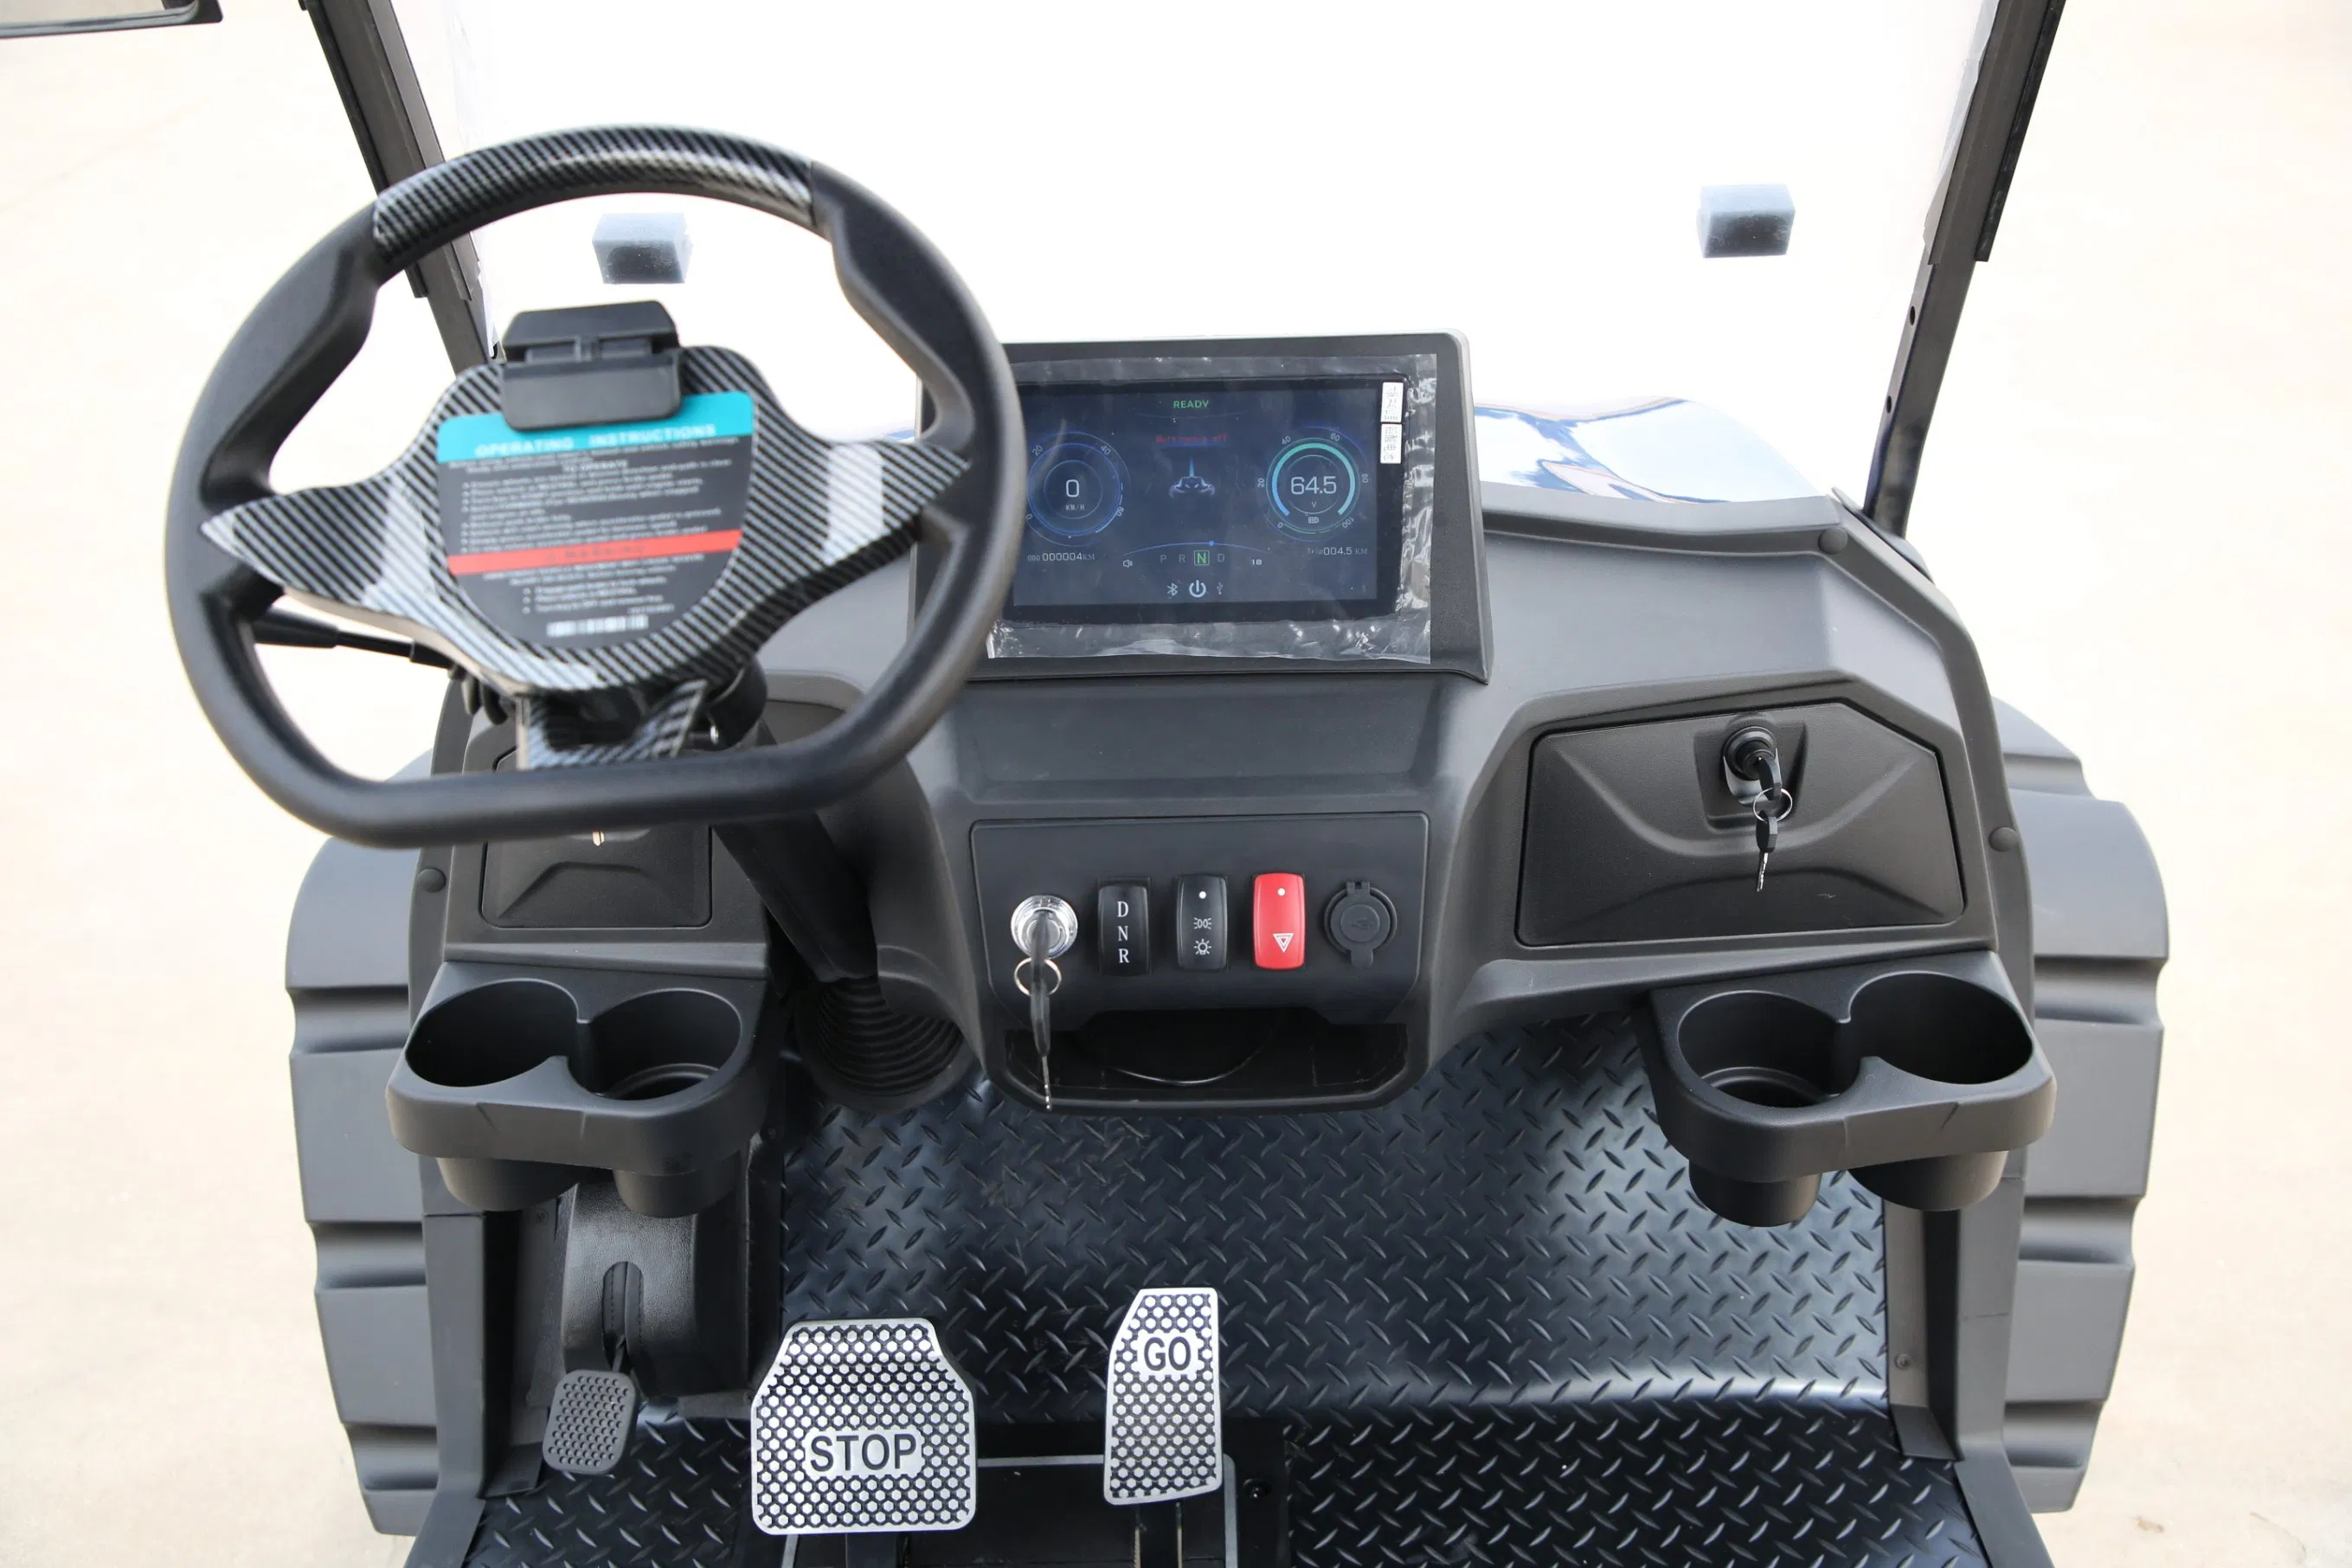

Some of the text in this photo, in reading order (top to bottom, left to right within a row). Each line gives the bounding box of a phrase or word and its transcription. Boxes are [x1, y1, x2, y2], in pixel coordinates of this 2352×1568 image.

[1173, 400, 1209, 408] READY
[474, 436, 574, 457] OPERATING
[588, 423, 717, 447] INSTRUCTIONS
[1282, 435, 1291, 445] 40
[1331, 433, 1340, 441] 60
[1031, 445, 1044, 456] 20
[1100, 445, 1112, 455] 40
[1257, 478, 1264, 487] 20
[1361, 473, 1369, 484] 80
[1065, 479, 1080, 498] 0
[1290, 476, 1337, 494] 64.5
[1115, 506, 1125, 517] 60
[1341, 517, 1355, 529] 100
[1160, 555, 1167, 563] P
[1197, 553, 1206, 564] N
[1218, 554, 1225, 562] D
[1117, 901, 1129, 917] D
[1118, 925, 1129, 941] N
[1118, 948, 1130, 963] R
[1144, 1336, 1192, 1372] GO
[810, 1433, 917, 1472] STOP
